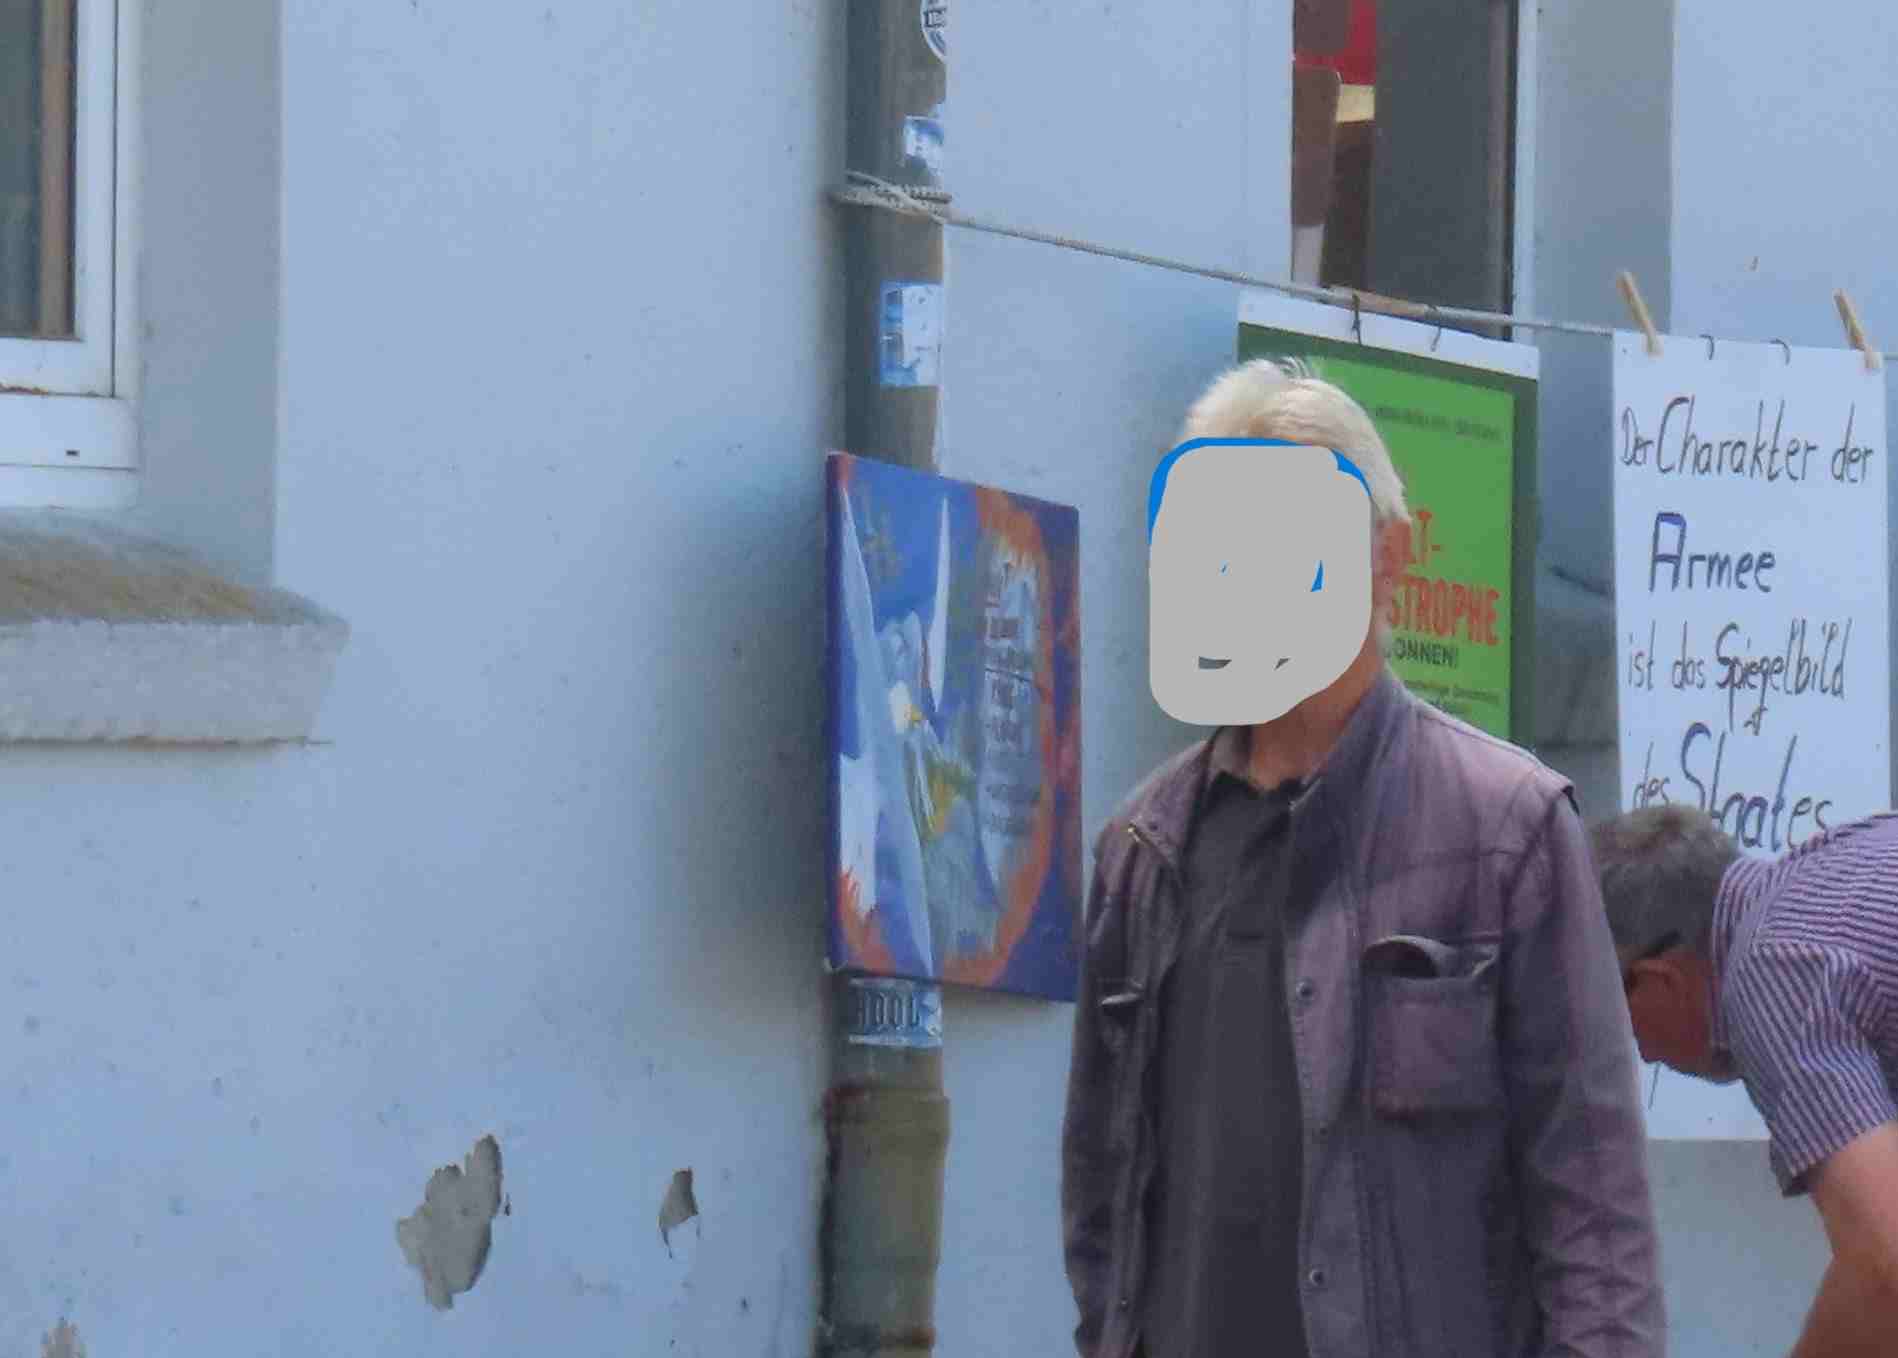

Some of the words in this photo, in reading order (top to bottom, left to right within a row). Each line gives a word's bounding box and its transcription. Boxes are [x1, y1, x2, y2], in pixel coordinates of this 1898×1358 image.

[1621, 403, 1655, 467] Der
[1656, 395, 1819, 483] Charakter
[1831, 400, 1873, 484] der
[1649, 511, 1777, 593] Armee
[1627, 619, 1656, 692] ist
[1671, 619, 1707, 691] das
[1714, 618, 1854, 737] Spiegelbild
[1680, 722, 1833, 853] Staates
